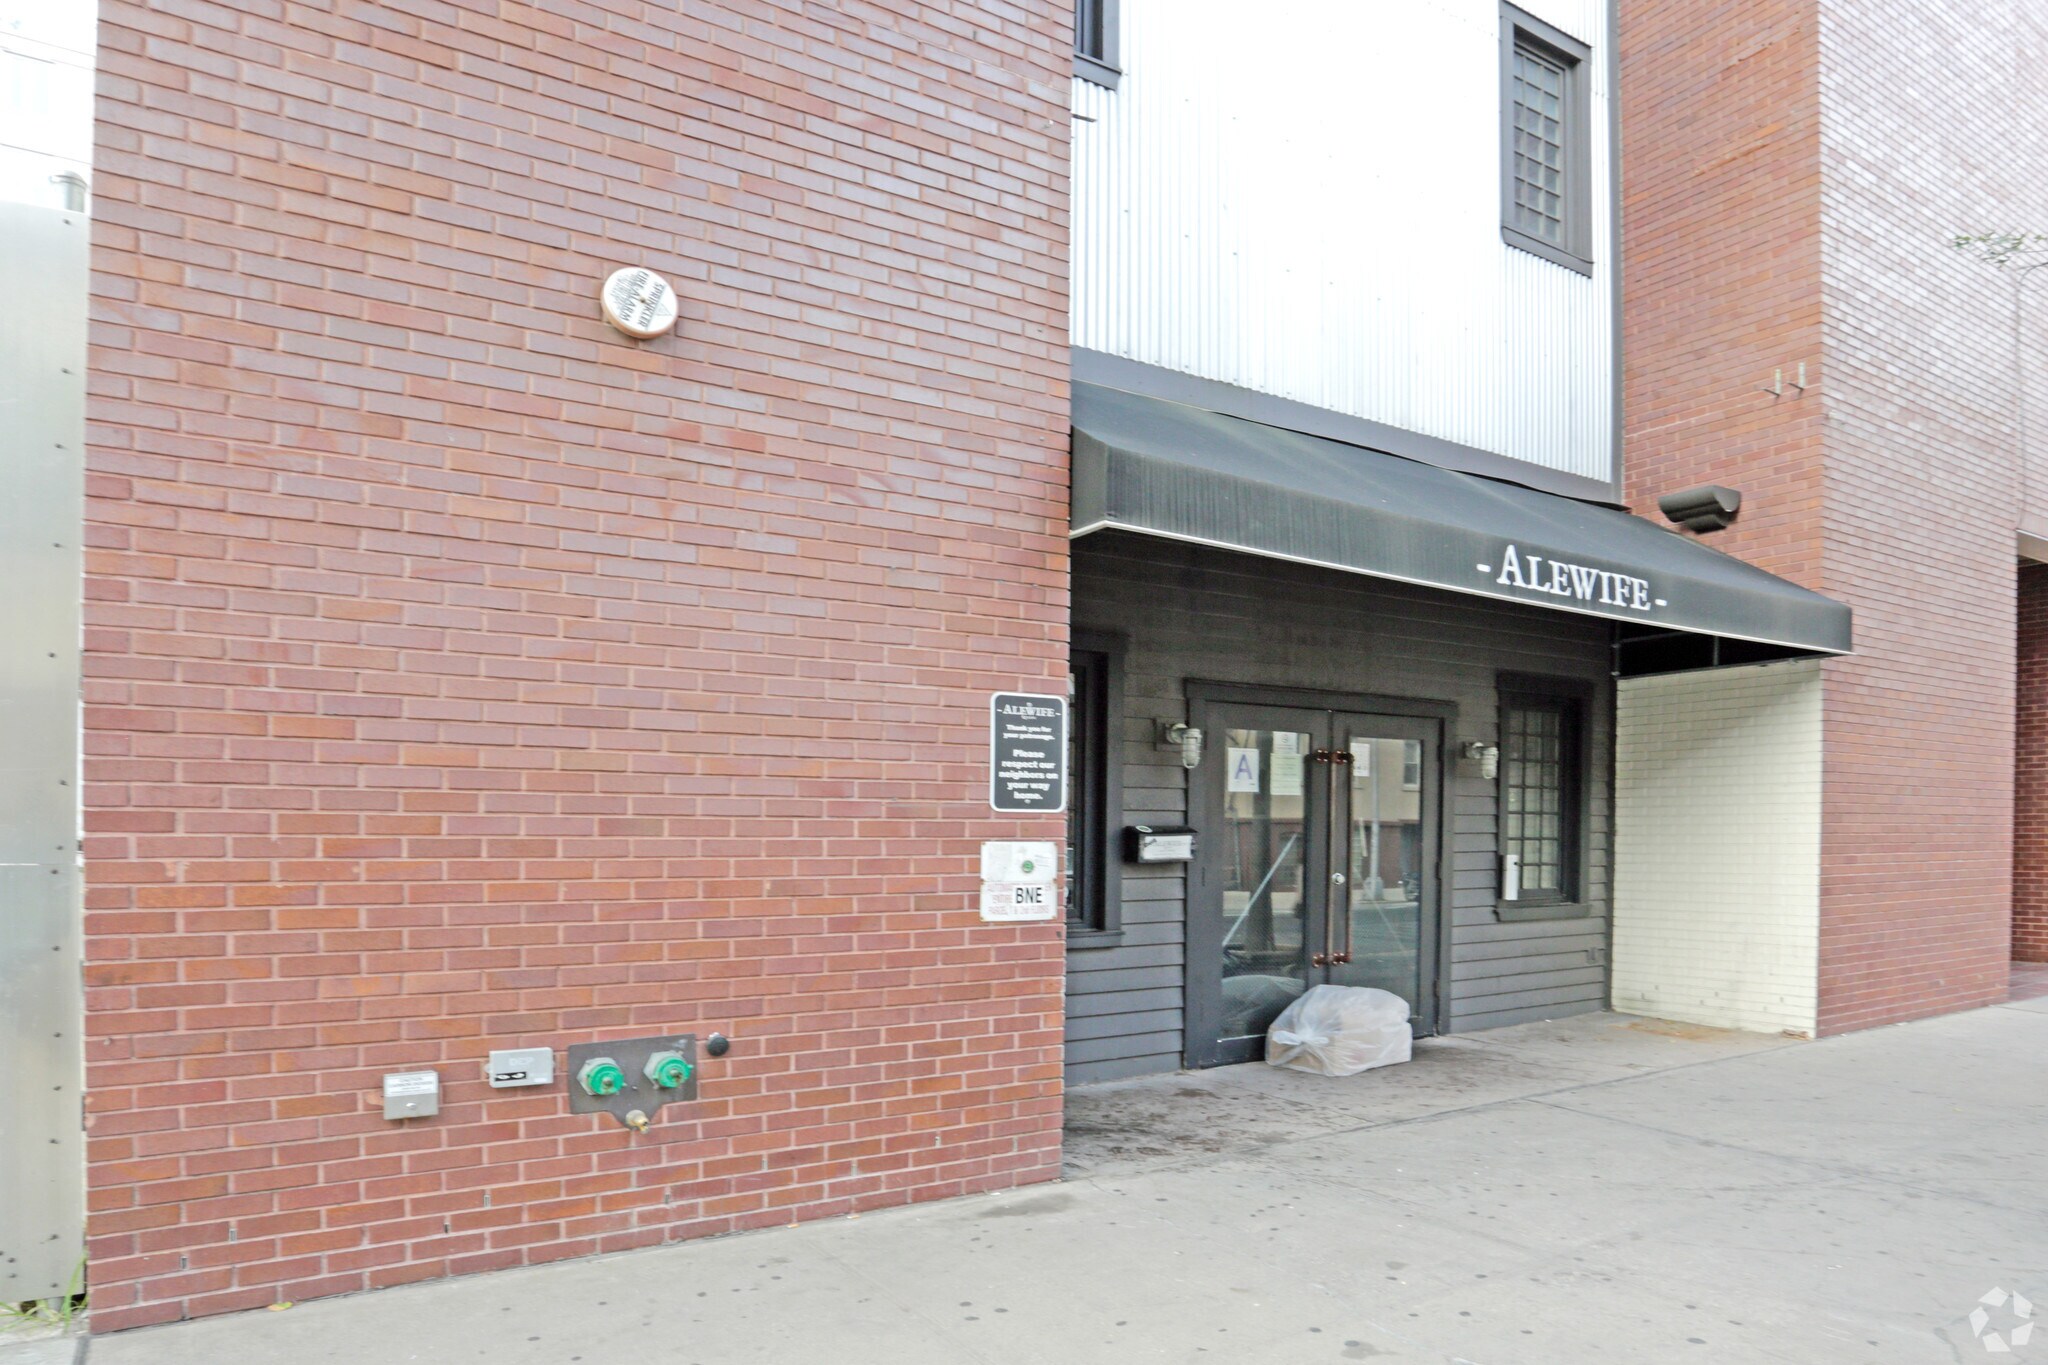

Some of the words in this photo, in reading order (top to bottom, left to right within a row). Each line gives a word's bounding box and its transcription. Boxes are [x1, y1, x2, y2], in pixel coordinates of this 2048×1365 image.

[619, 287, 640, 321] ALARM
[638, 282, 665, 328] SPRINKLER
[1012, 749, 1046, 758] Please
[1001, 760, 1038, 769] respect
[1234, 754, 1253, 780] A
[998, 770, 1045, 780] neighbors
[1006, 782, 1029, 790] your
[1029, 783, 1050, 791] way
[1013, 791, 1043, 799] home.
[1016, 887, 1042, 904] BNE
